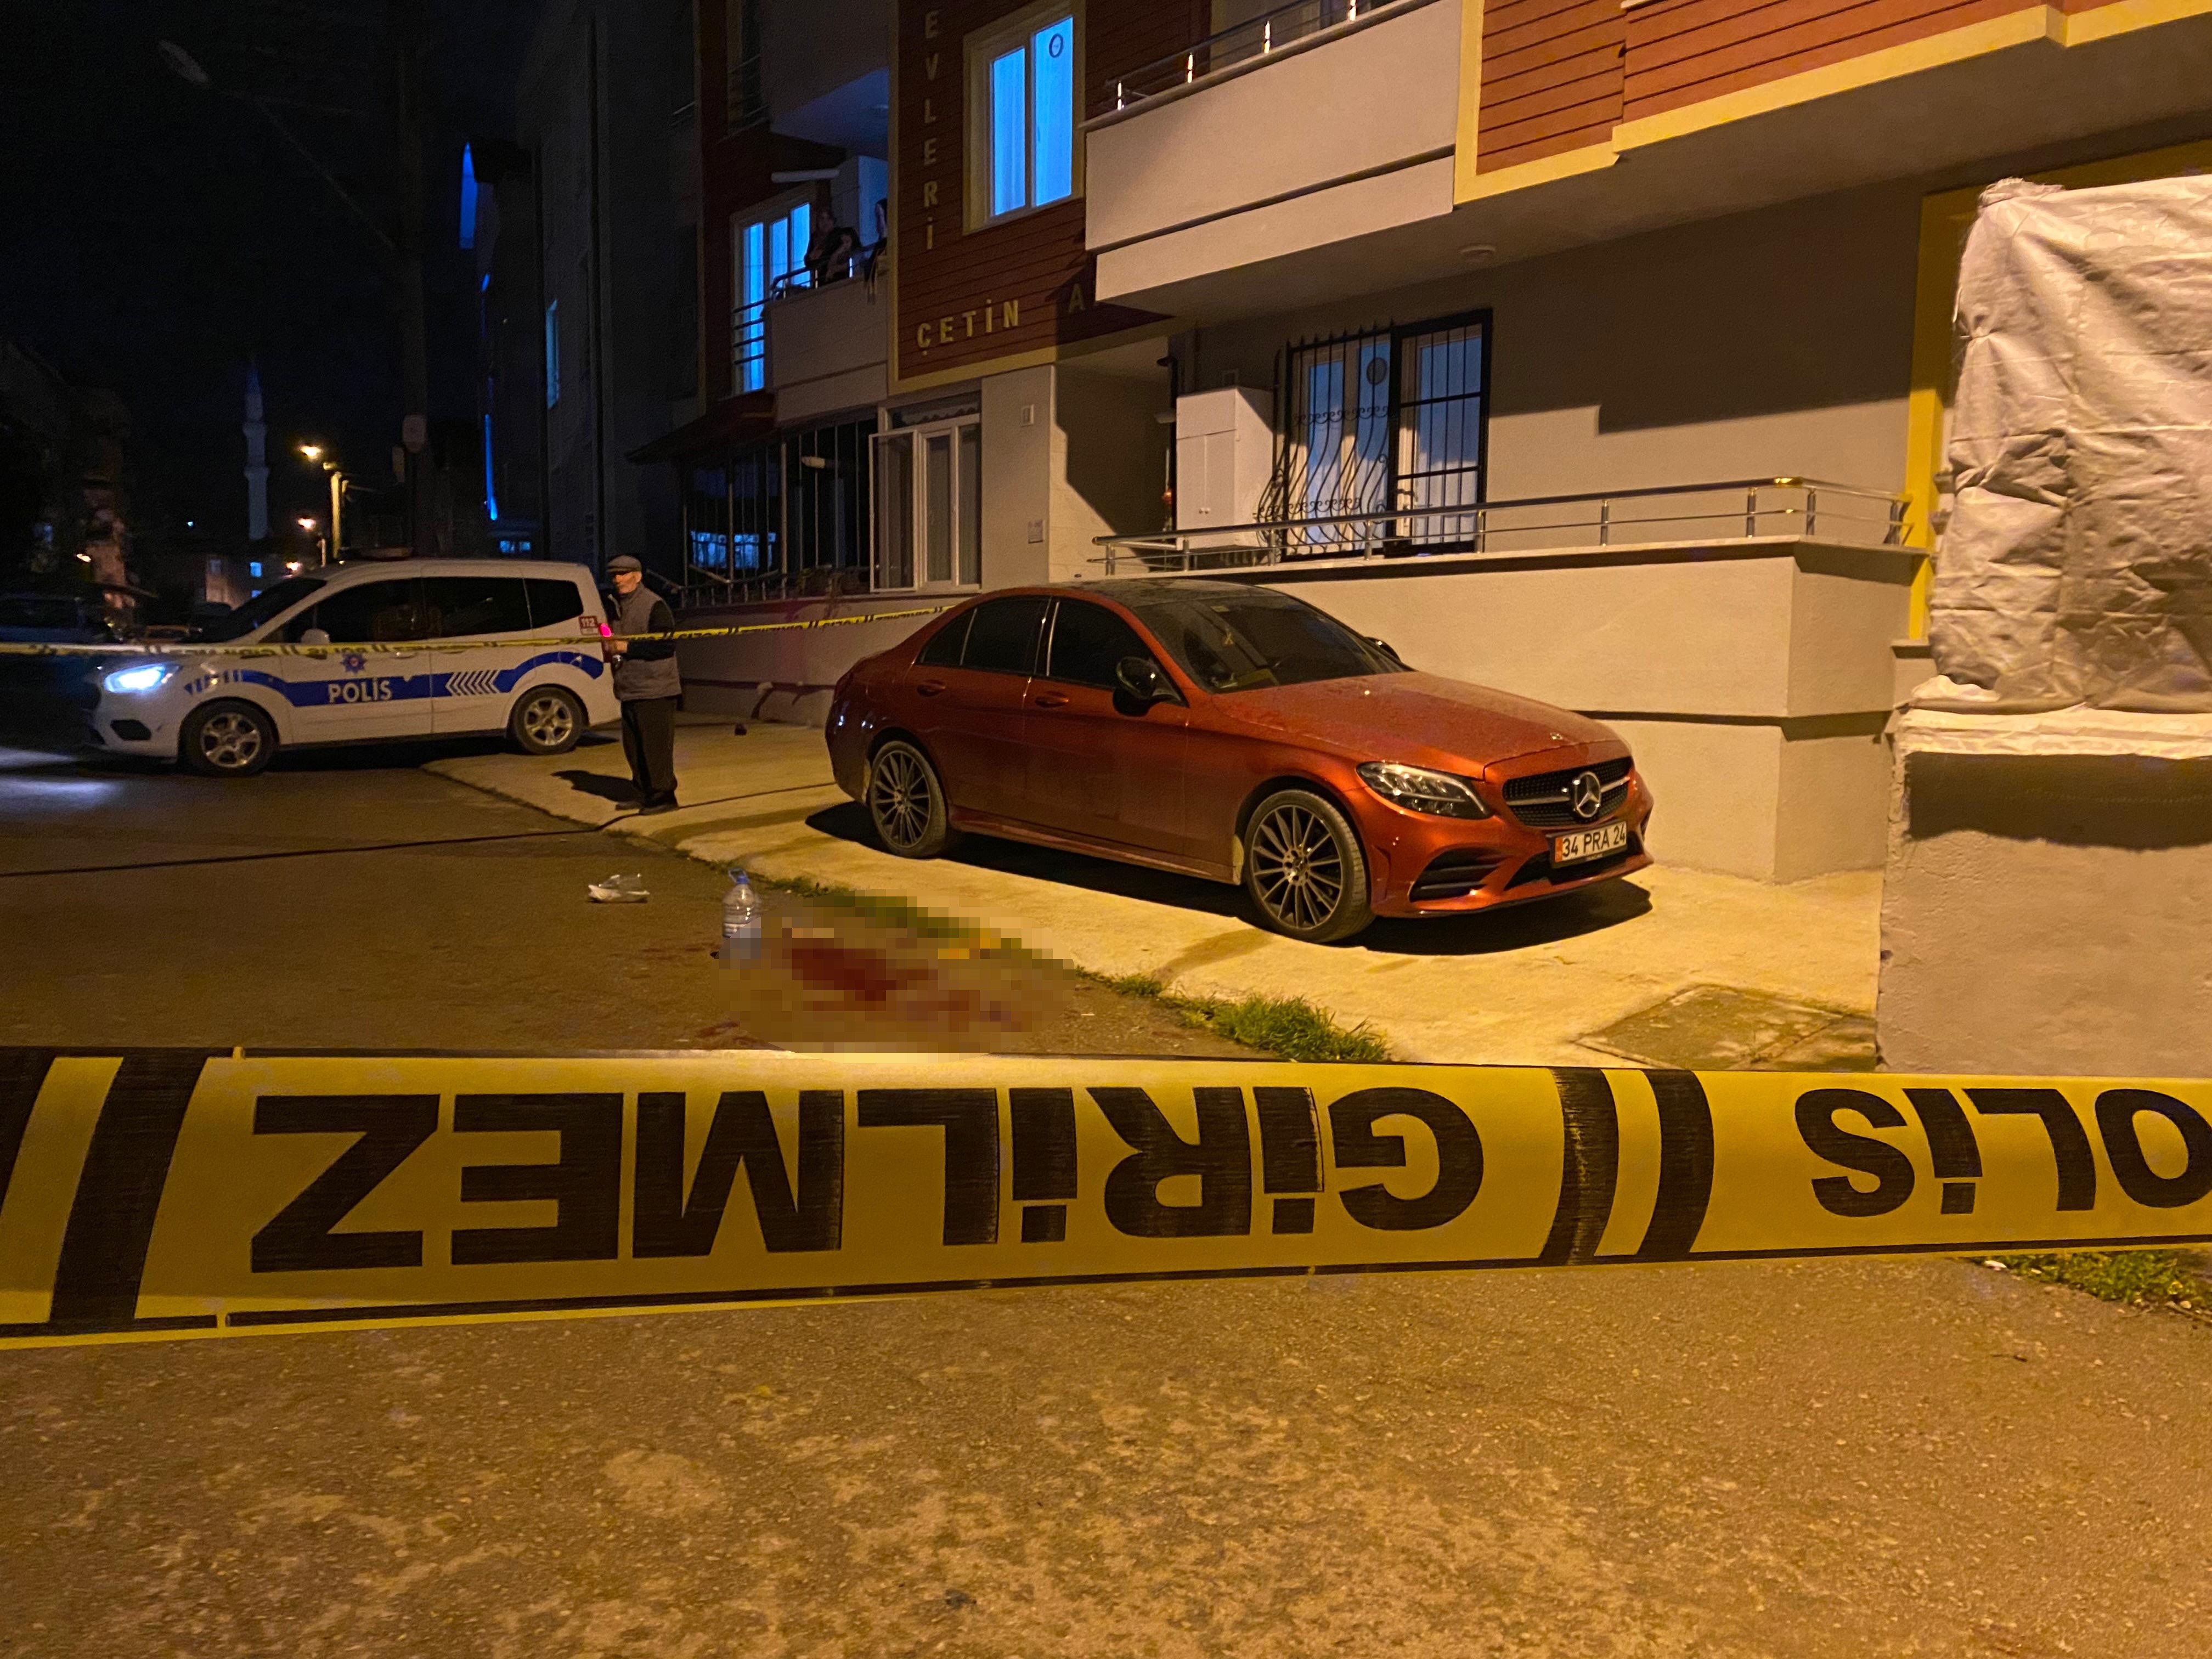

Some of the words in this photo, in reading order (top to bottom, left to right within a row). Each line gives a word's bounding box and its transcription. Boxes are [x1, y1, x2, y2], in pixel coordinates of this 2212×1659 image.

[917, 299, 1019, 356] ÇETİN
[328, 676, 393, 703] POLİS
[1562, 836, 1578, 857] 34
[1583, 829, 1610, 854] PRA
[1613, 823, 1625, 844] 24
[251, 1086, 1484, 1273] GİRİLMEZ
[1795, 1087, 2212, 1217] OLİS
